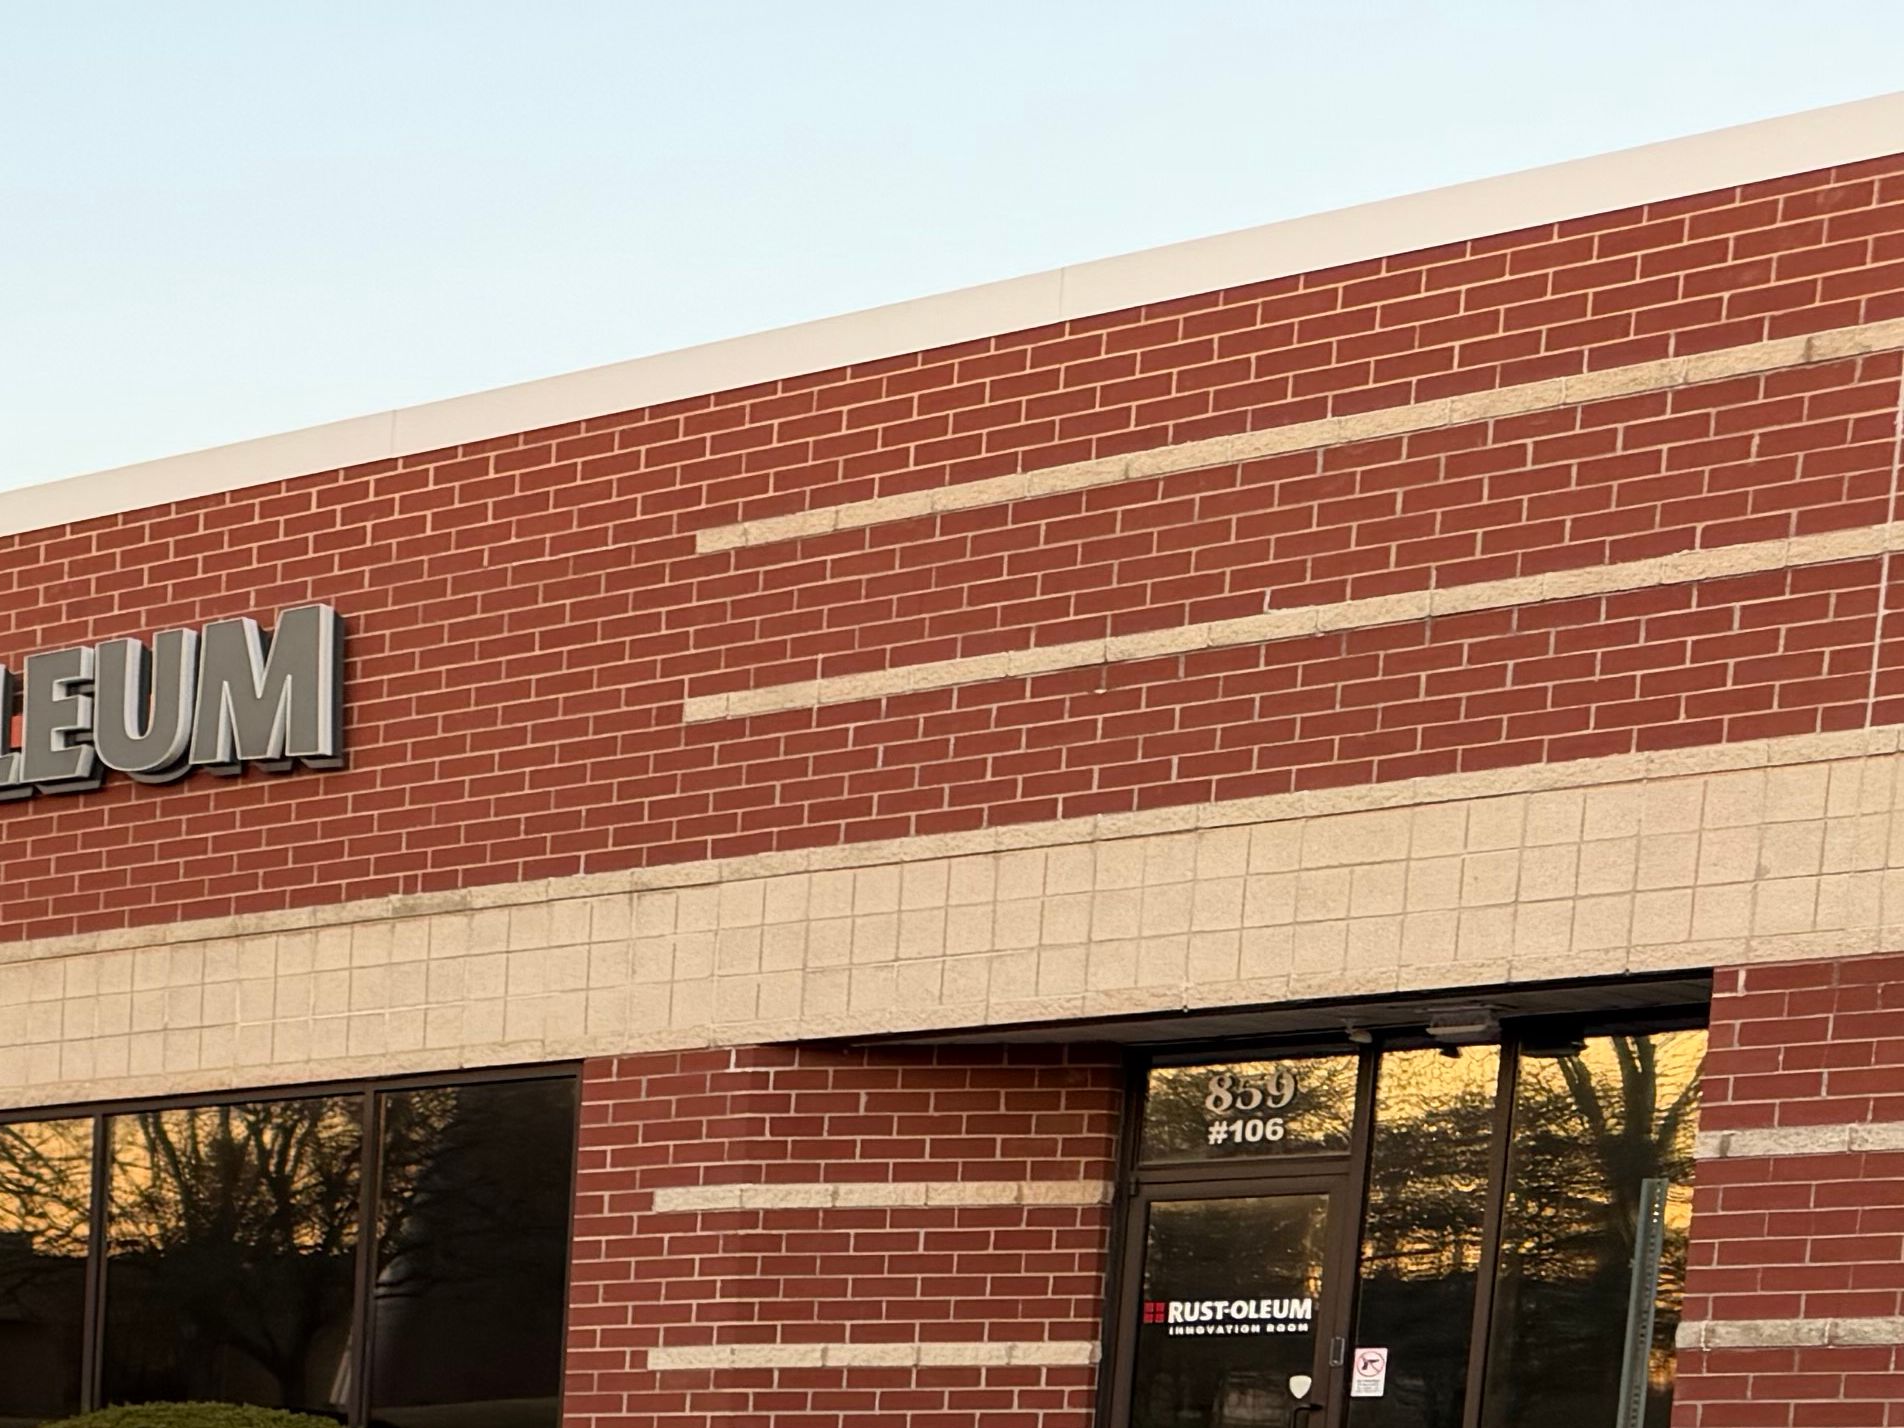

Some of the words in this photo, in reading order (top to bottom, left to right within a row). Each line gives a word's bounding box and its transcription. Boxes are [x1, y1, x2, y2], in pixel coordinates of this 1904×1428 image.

[1205, 1068, 1295, 1115] 859
[1208, 1118, 1284, 1144] #106
[1168, 1298, 1312, 1323] RUST-OLEUM
[1168, 1324, 1260, 1335] INNOVATION
[1266, 1323, 1309, 1333] ROOM
